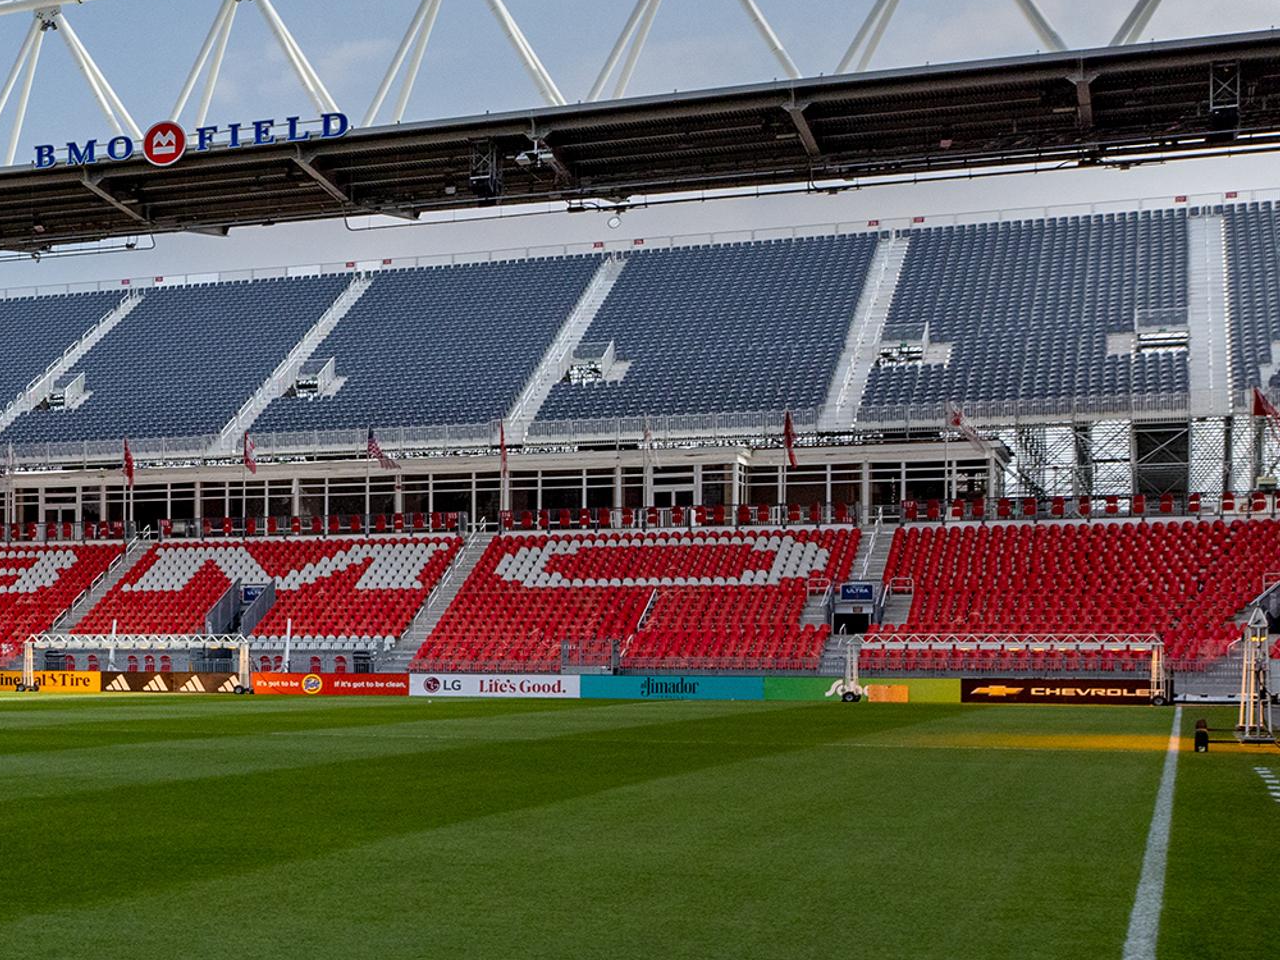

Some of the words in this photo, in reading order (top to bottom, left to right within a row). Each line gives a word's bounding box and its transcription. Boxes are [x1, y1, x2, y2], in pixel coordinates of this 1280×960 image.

[33, 135, 134, 169] BMO
[195, 111, 350, 152] FIELD
[58, 673, 90, 687] Tire
[443, 679, 462, 691] LG
[479, 678, 517, 693] Life's
[519, 679, 567, 694] Good.
